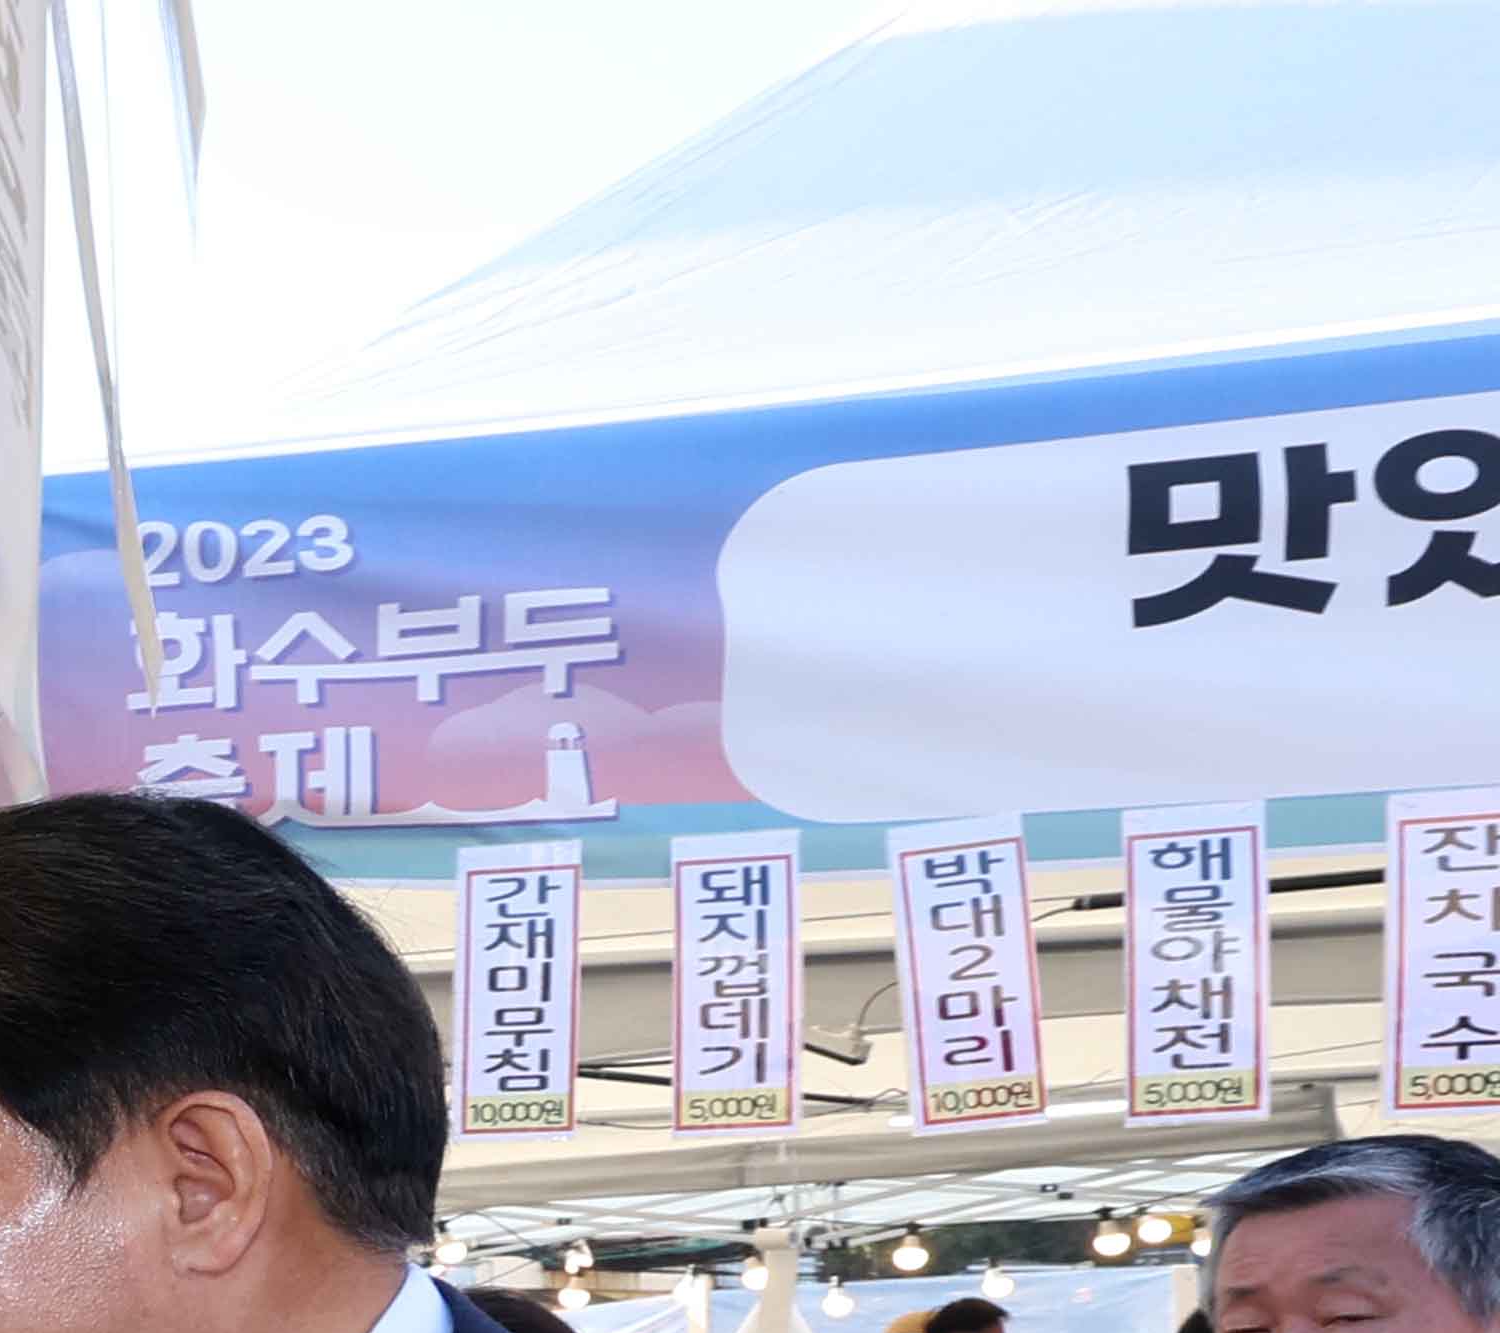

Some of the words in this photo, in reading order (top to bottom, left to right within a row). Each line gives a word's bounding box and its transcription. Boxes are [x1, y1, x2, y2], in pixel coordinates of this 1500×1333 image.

[138, 514, 354, 588] 2023
[127, 587, 620, 711] 화수부두
[483, 874, 562, 1093] 간재미무침
[695, 864, 770, 1084] 돼지껍데기
[1148, 837, 1241, 1070] 해물야채전
[1421, 823, 1500, 1061] 잔치국수
[469, 1099, 564, 1126] 10,000원
[688, 1093, 777, 1123] 5,000원
[931, 1080, 1033, 1115] 10,000원
[1144, 1075, 1244, 1108] 5,000원
